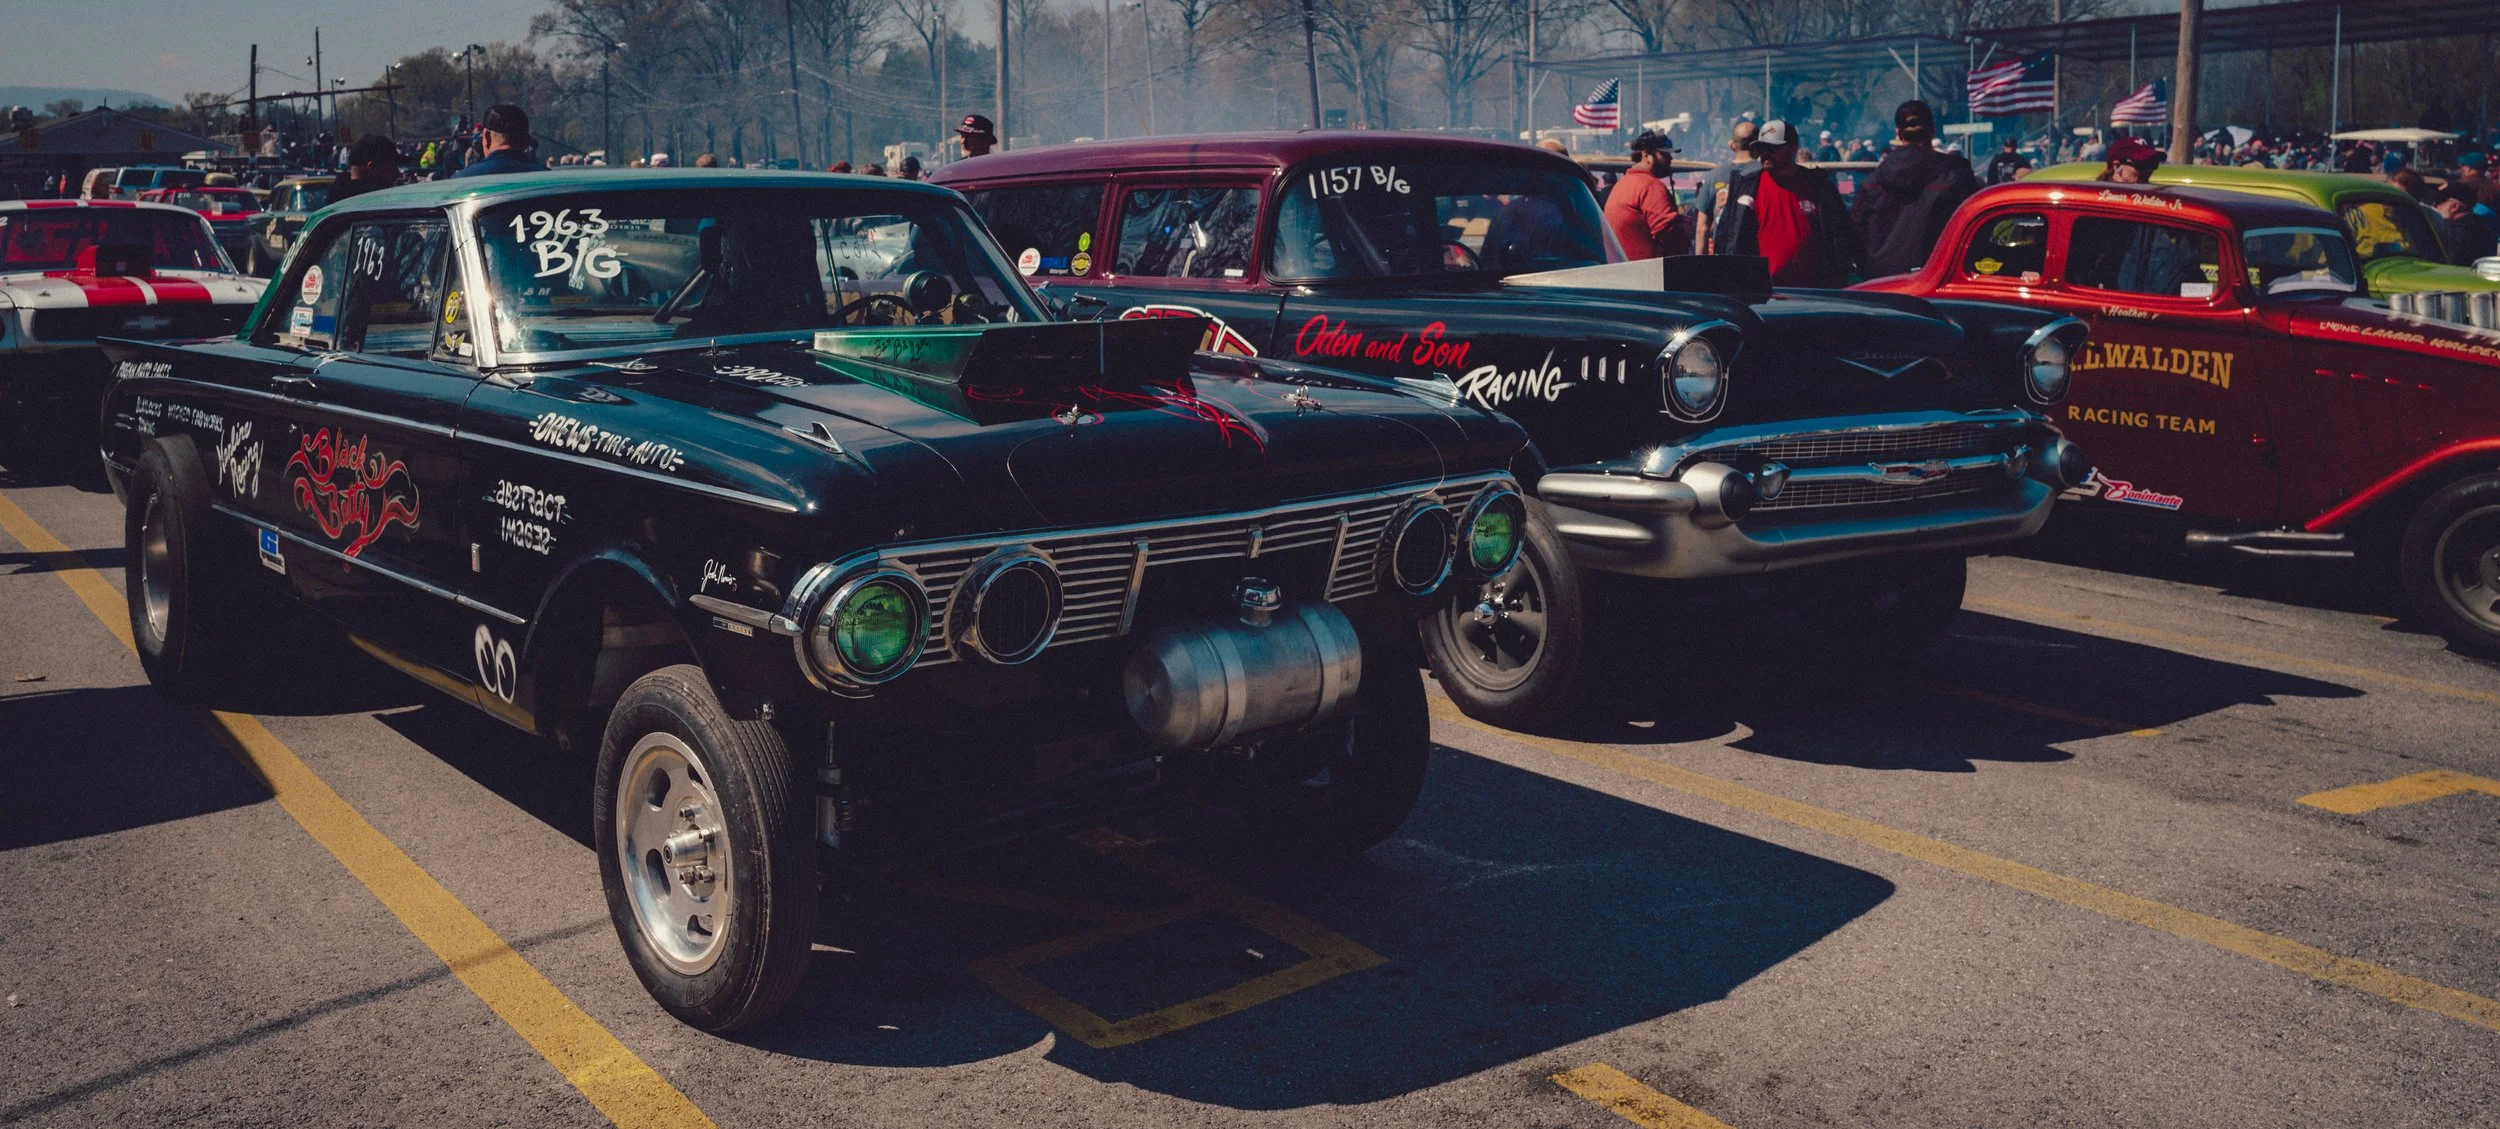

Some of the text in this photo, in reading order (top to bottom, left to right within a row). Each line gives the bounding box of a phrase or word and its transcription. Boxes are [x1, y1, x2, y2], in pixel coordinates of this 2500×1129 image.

[1309, 166, 1361, 199] 1157
[508, 209, 609, 243] 1963
[353, 237, 385, 281] 1963
[1295, 315, 1363, 356] Oden
[1365, 334, 1410, 364] and
[1412, 321, 1471, 368] Son
[2067, 405, 2216, 434] RACING TEAM
